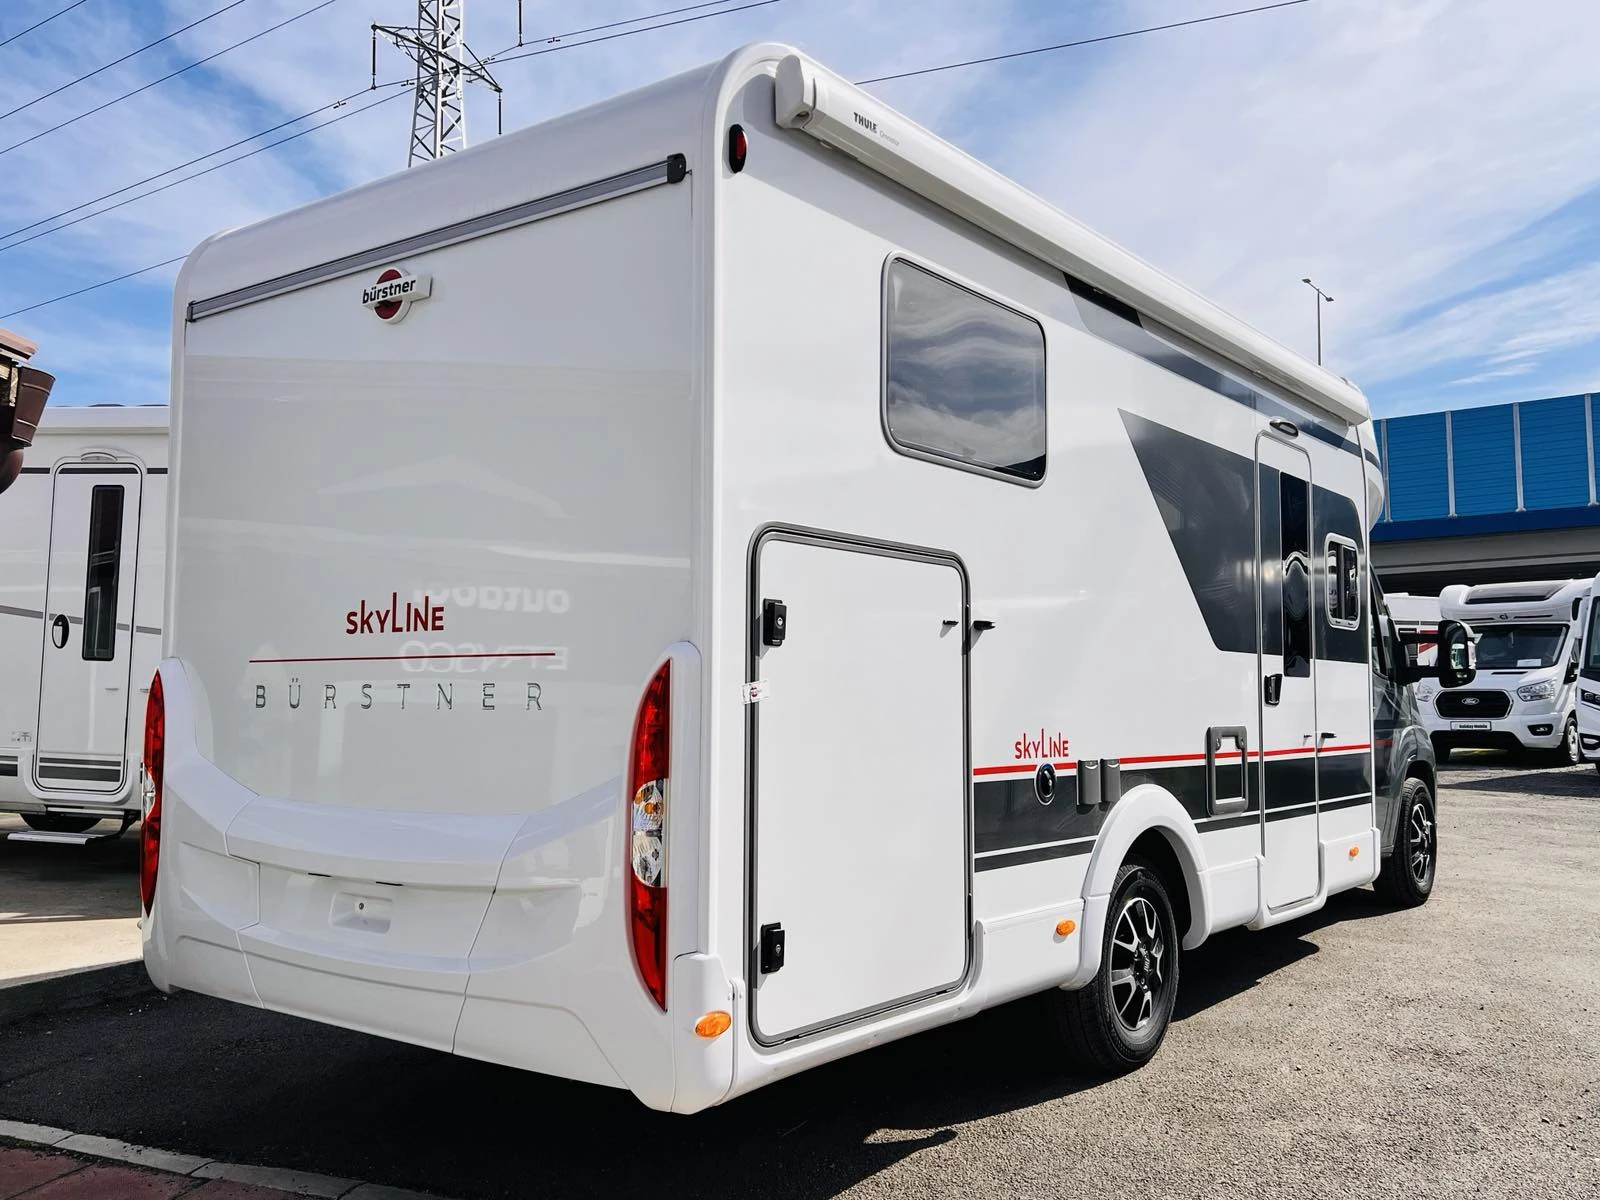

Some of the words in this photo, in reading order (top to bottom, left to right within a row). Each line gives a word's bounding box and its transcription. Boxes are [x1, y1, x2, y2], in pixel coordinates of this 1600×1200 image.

[853, 111, 878, 134] THULE
[362, 279, 416, 304] bürstner
[254, 677, 543, 711] BÜRSTNER
